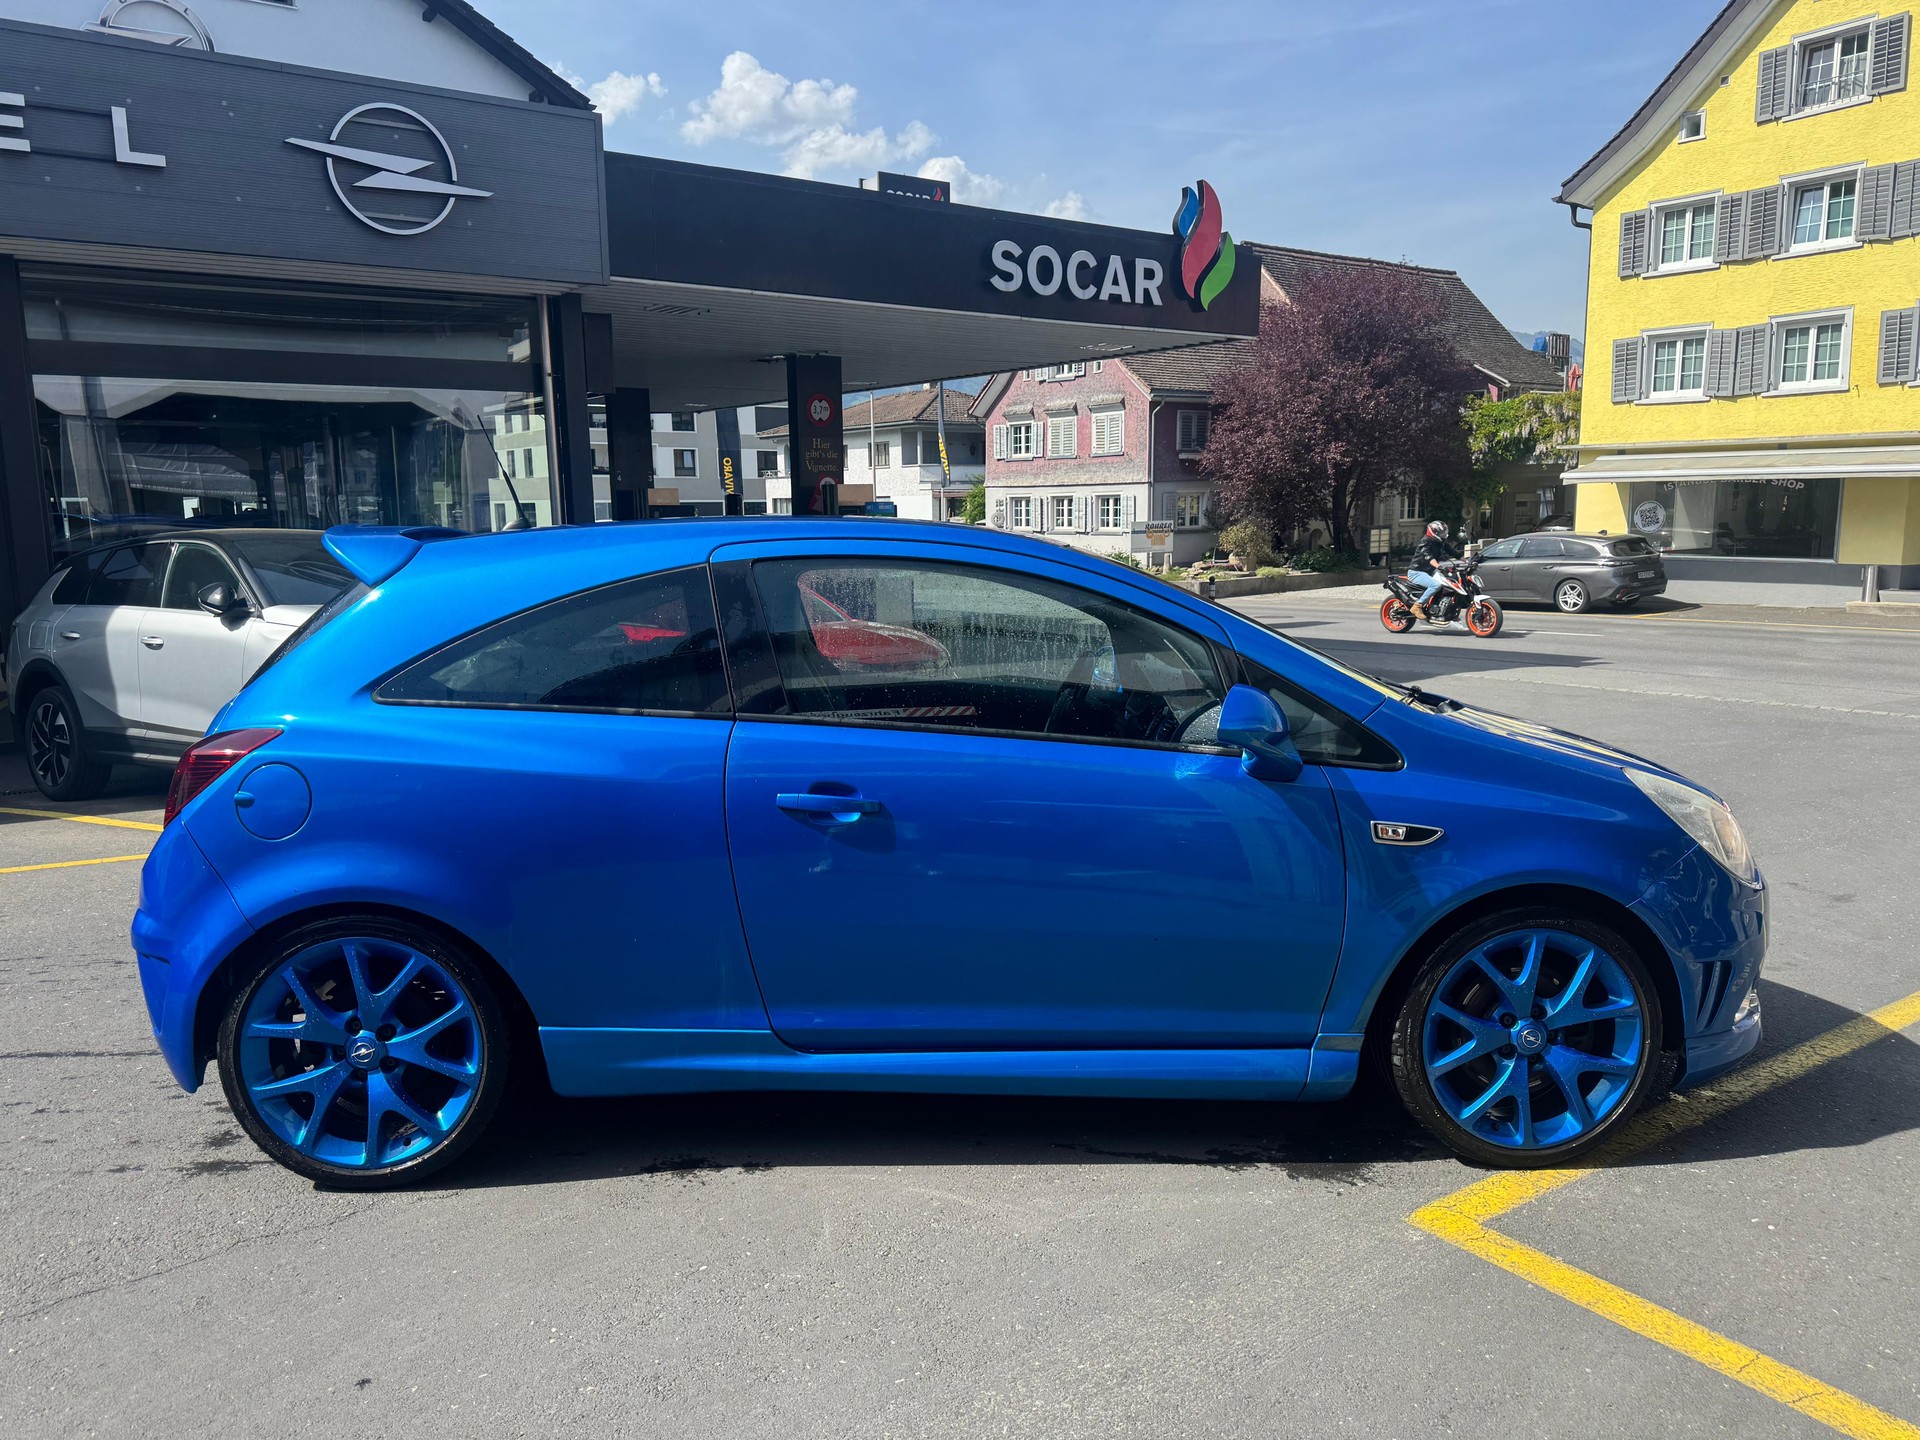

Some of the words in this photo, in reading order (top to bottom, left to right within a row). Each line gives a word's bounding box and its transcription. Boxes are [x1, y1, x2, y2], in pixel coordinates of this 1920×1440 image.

[989, 239, 1164, 306] SOCAR
[812, 438, 831, 449] Hier
[805, 450, 826, 460] gibt's
[826, 450, 838, 459] die
[805, 460, 839, 473] Vignette.
[1771, 478, 1804, 490] SHOP
